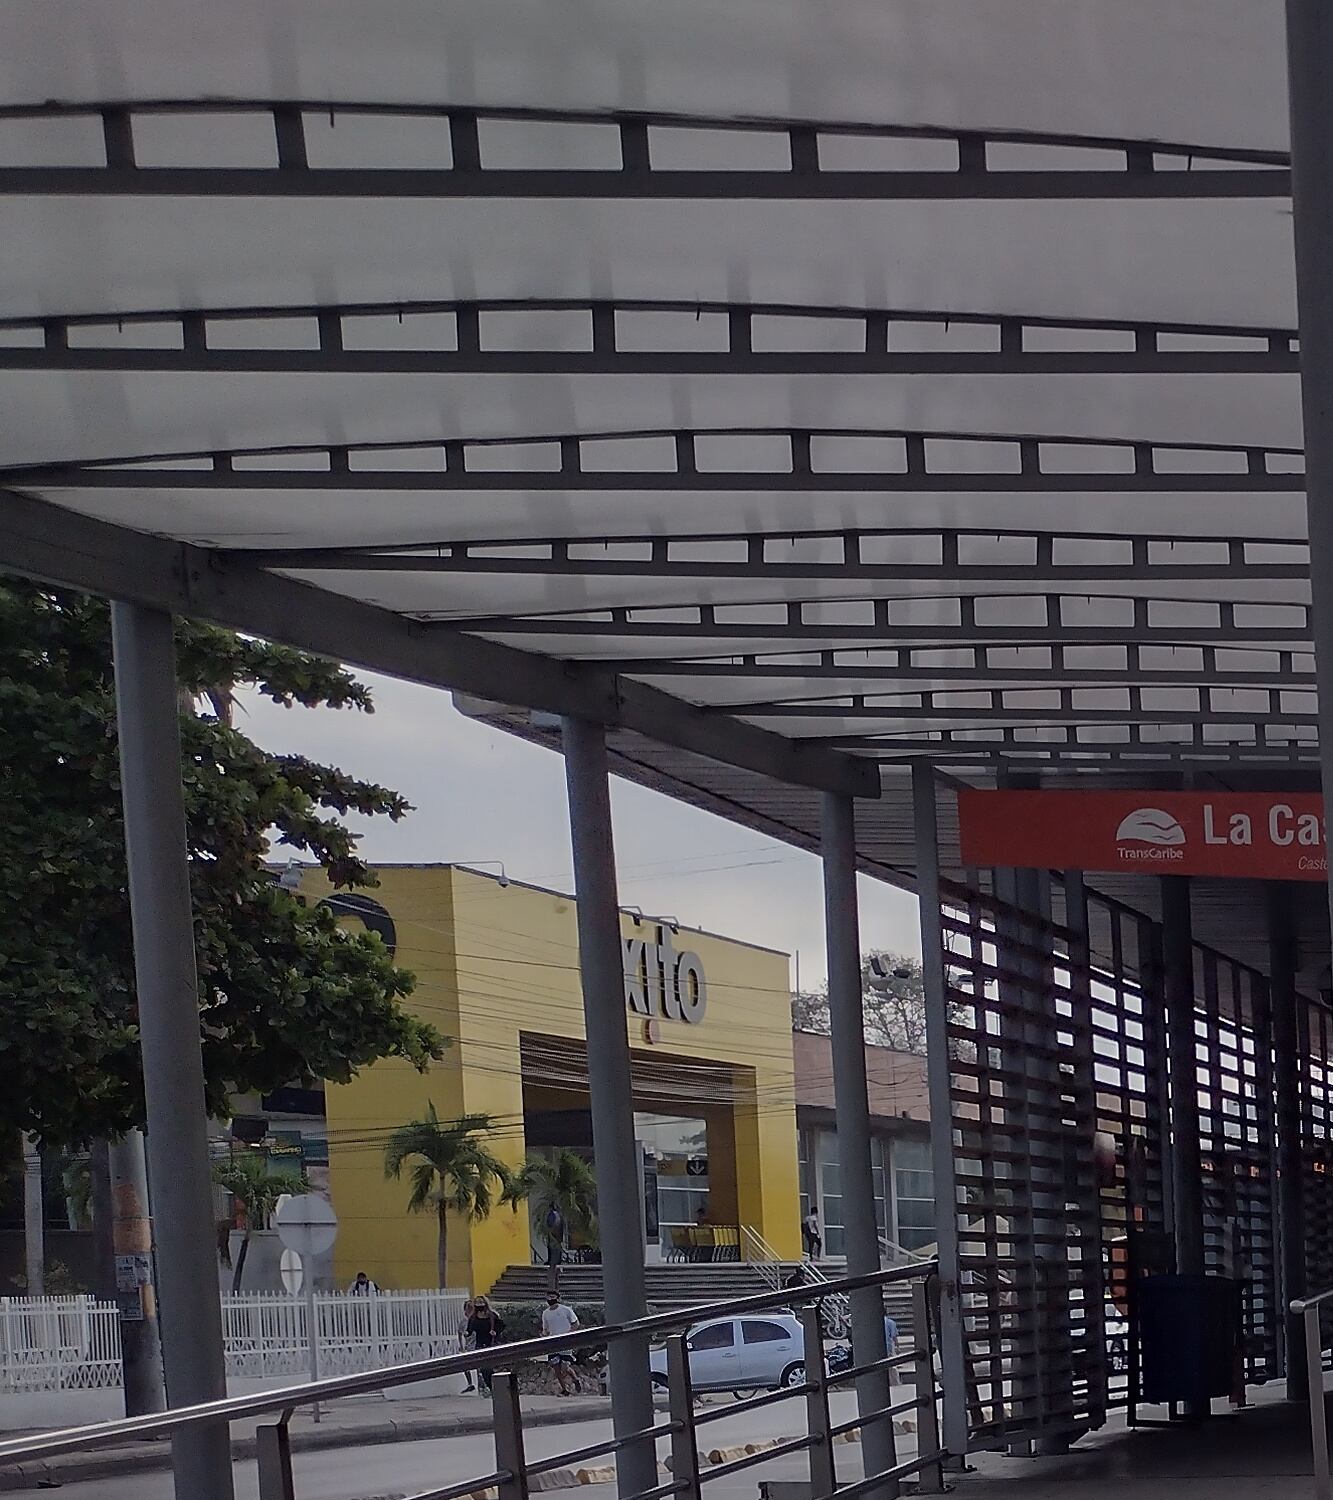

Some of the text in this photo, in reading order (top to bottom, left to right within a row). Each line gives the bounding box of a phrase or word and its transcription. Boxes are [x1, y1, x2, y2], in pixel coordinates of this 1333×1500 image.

[1203, 804, 1252, 845] La
[1117, 847, 1184, 860] TransCaribe
[622, 925, 708, 1040] xito
